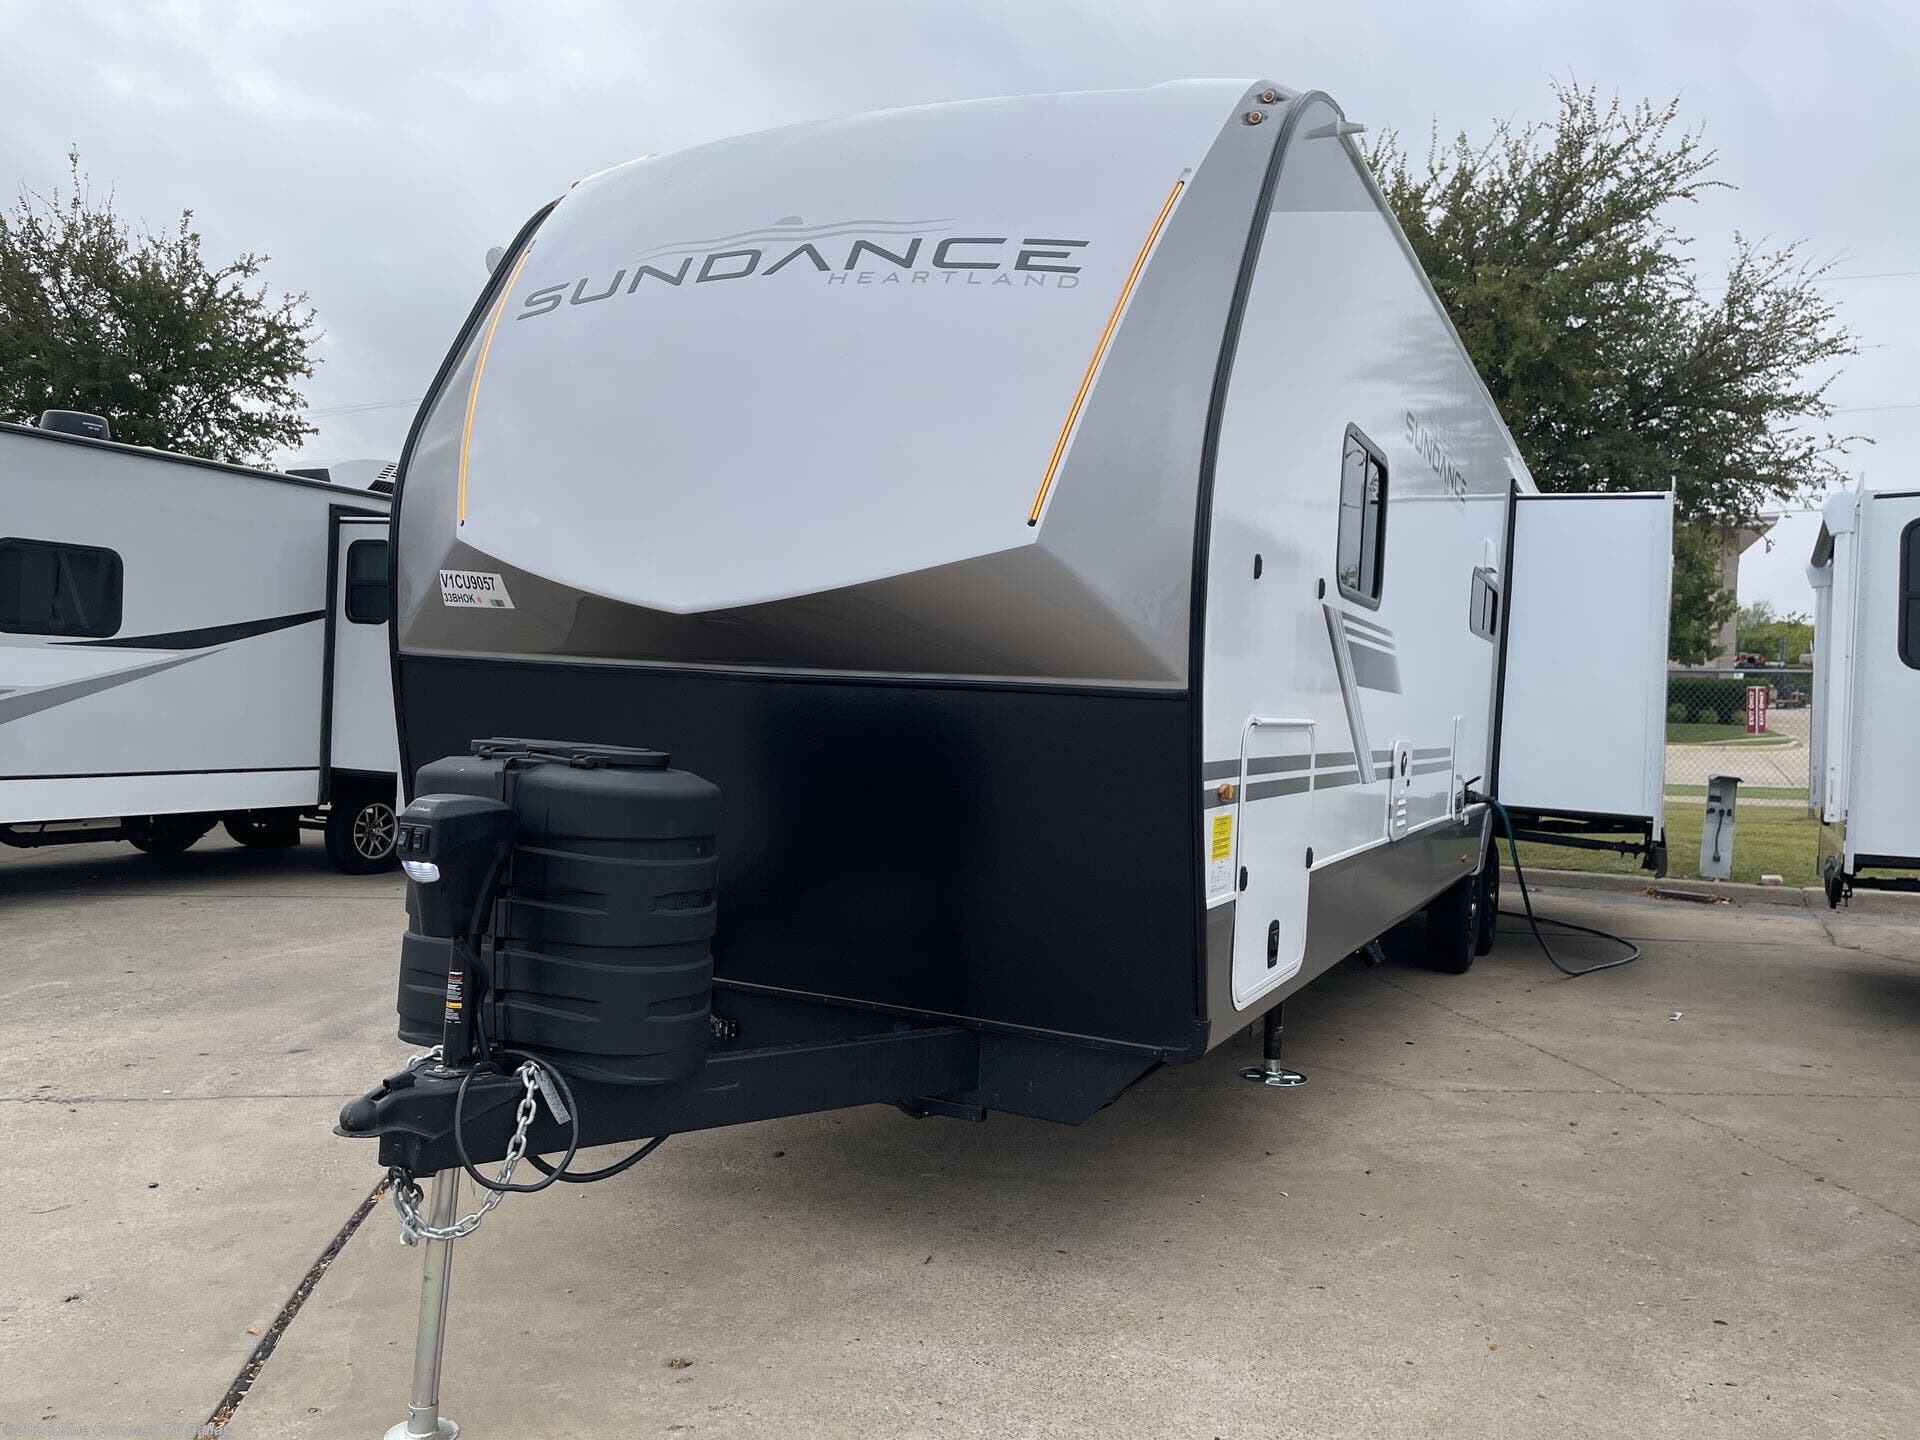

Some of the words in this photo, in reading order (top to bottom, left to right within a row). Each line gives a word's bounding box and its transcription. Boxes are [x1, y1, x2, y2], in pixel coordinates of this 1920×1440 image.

[516, 237, 1090, 321] SUNDANCE
[827, 270, 1081, 289] HEARTLAND
[1405, 411, 1467, 503] SUNDANCE
[441, 574, 495, 590] V1CU9057
